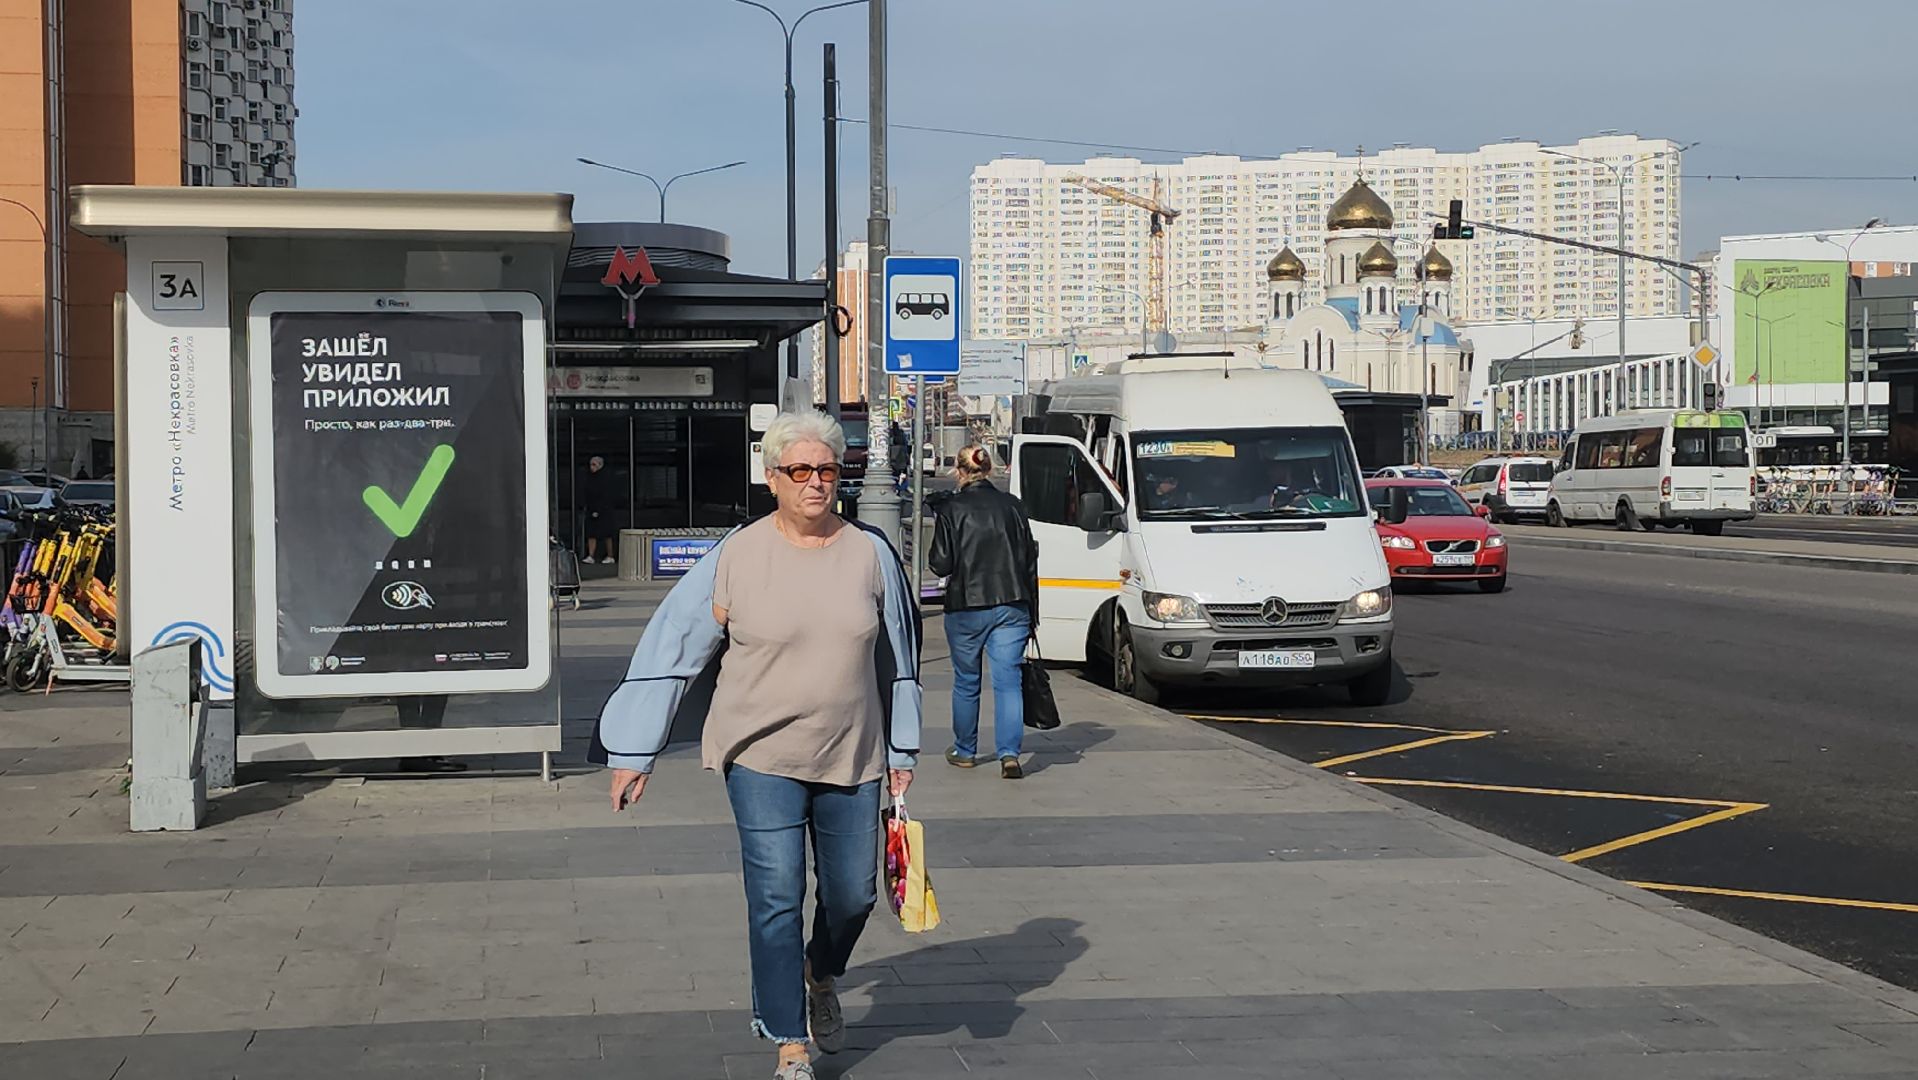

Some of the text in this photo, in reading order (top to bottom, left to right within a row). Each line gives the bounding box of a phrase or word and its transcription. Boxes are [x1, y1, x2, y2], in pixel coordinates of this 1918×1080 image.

[301, 331, 388, 357] ЗАШЁЛ
[301, 362, 402, 385] УВИДЕЛ
[303, 386, 450, 408] ПРИЛОЖИЛ
[355, 420, 377, 429] как
[169, 455, 184, 512] Метро
